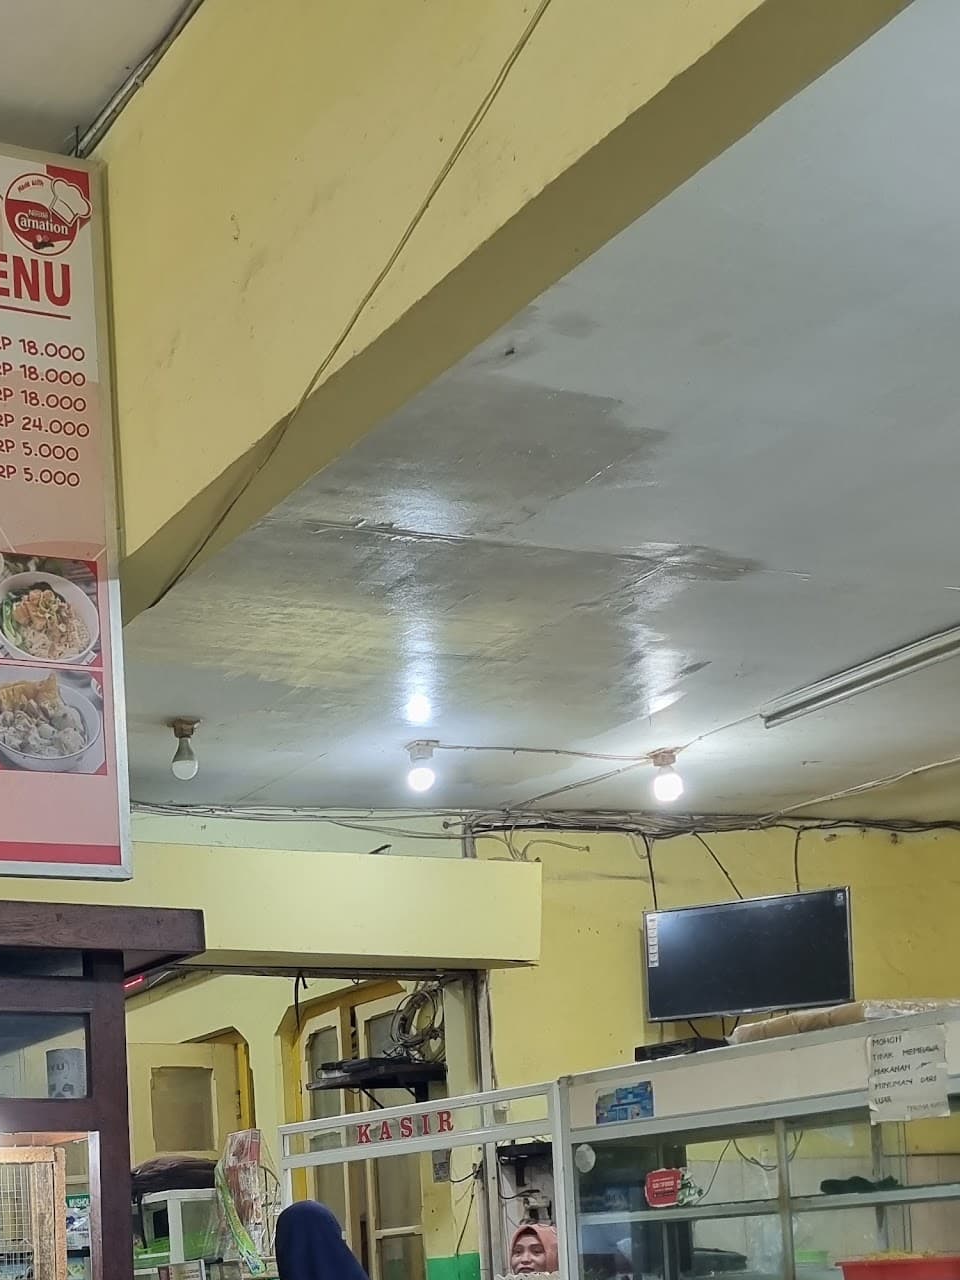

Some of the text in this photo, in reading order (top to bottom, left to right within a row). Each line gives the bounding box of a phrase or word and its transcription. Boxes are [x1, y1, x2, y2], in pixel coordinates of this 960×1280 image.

[14, 212, 69, 235] Carnation
[19, 339, 85, 361] 18.000
[19, 364, 85, 386] 18.000
[20, 390, 86, 412] 18.000
[22, 417, 89, 437] 24.000
[22, 442, 79, 461] 5.000
[24, 468, 80, 487] 5.000
[356, 1110, 454, 1144] KASIR
